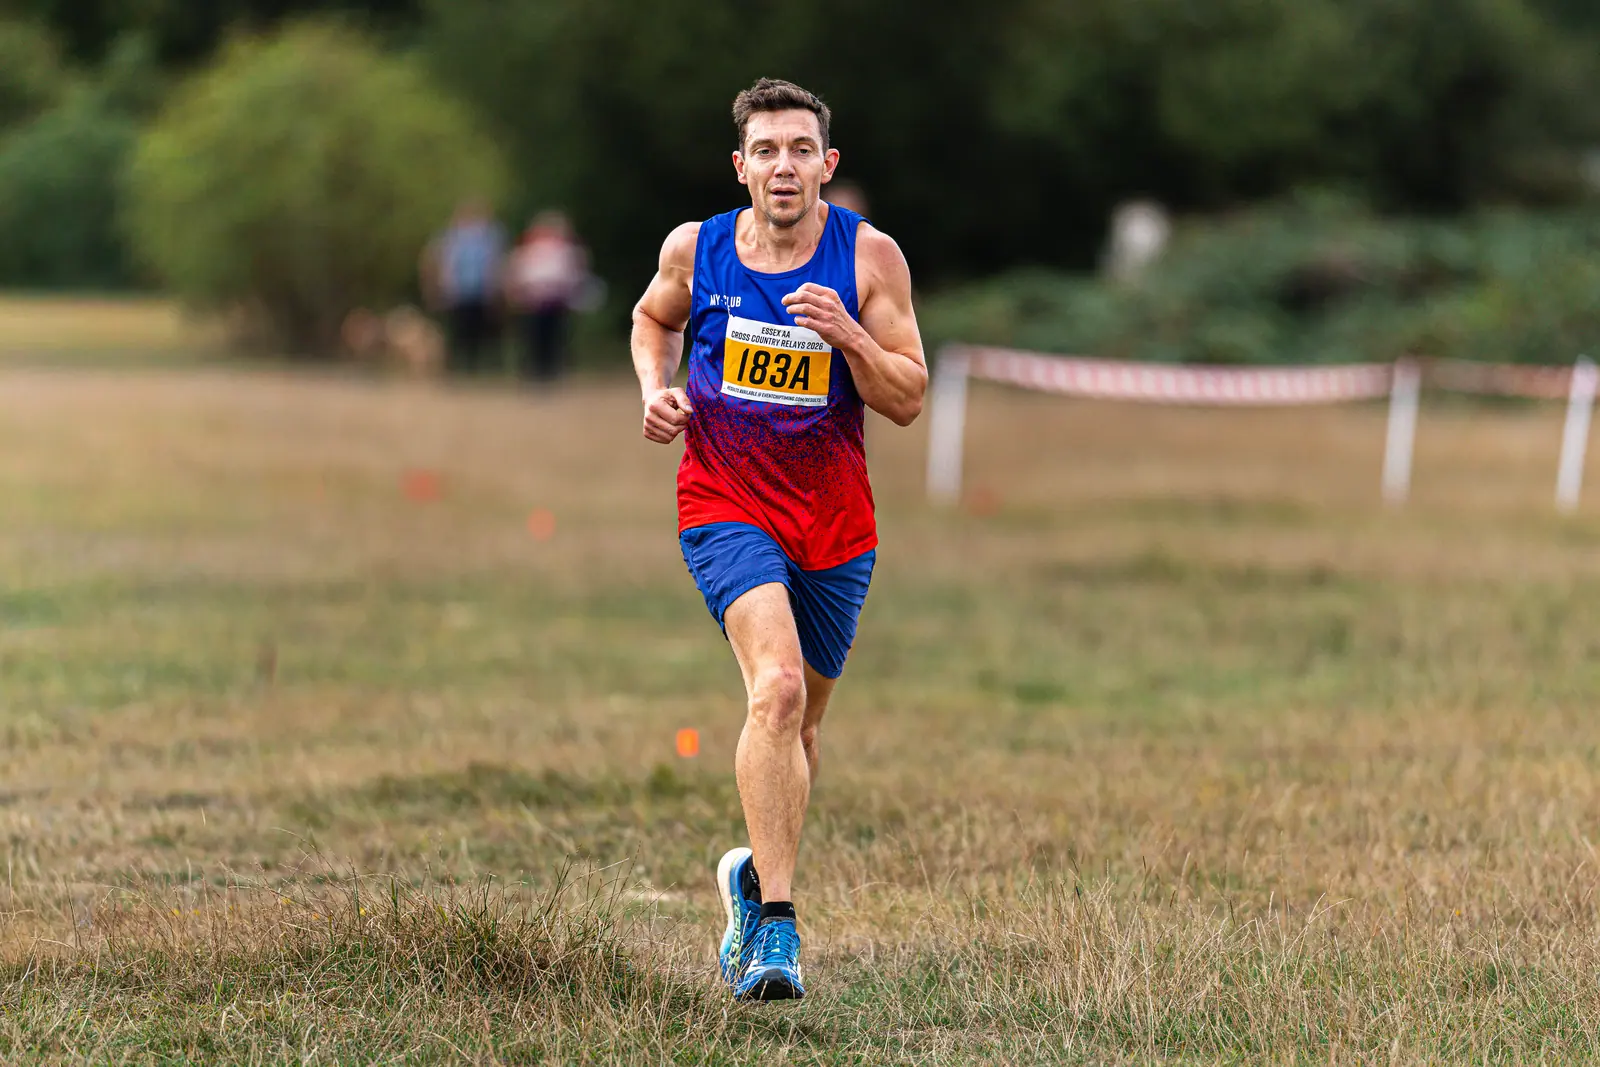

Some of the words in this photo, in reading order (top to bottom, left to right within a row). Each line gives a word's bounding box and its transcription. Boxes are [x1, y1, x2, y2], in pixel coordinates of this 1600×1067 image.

[710, 294, 721, 306] MY
[761, 327, 781, 337] ESSEX
[782, 330, 791, 338] AA
[731, 330, 751, 342] CROSS
[751, 335, 780, 346] COUNTRY
[781, 340, 806, 350] RELAYS
[806, 342, 824, 350] 2026
[737, 348, 810, 391] 183A
[740, 389, 757, 397] AVAILABLE
